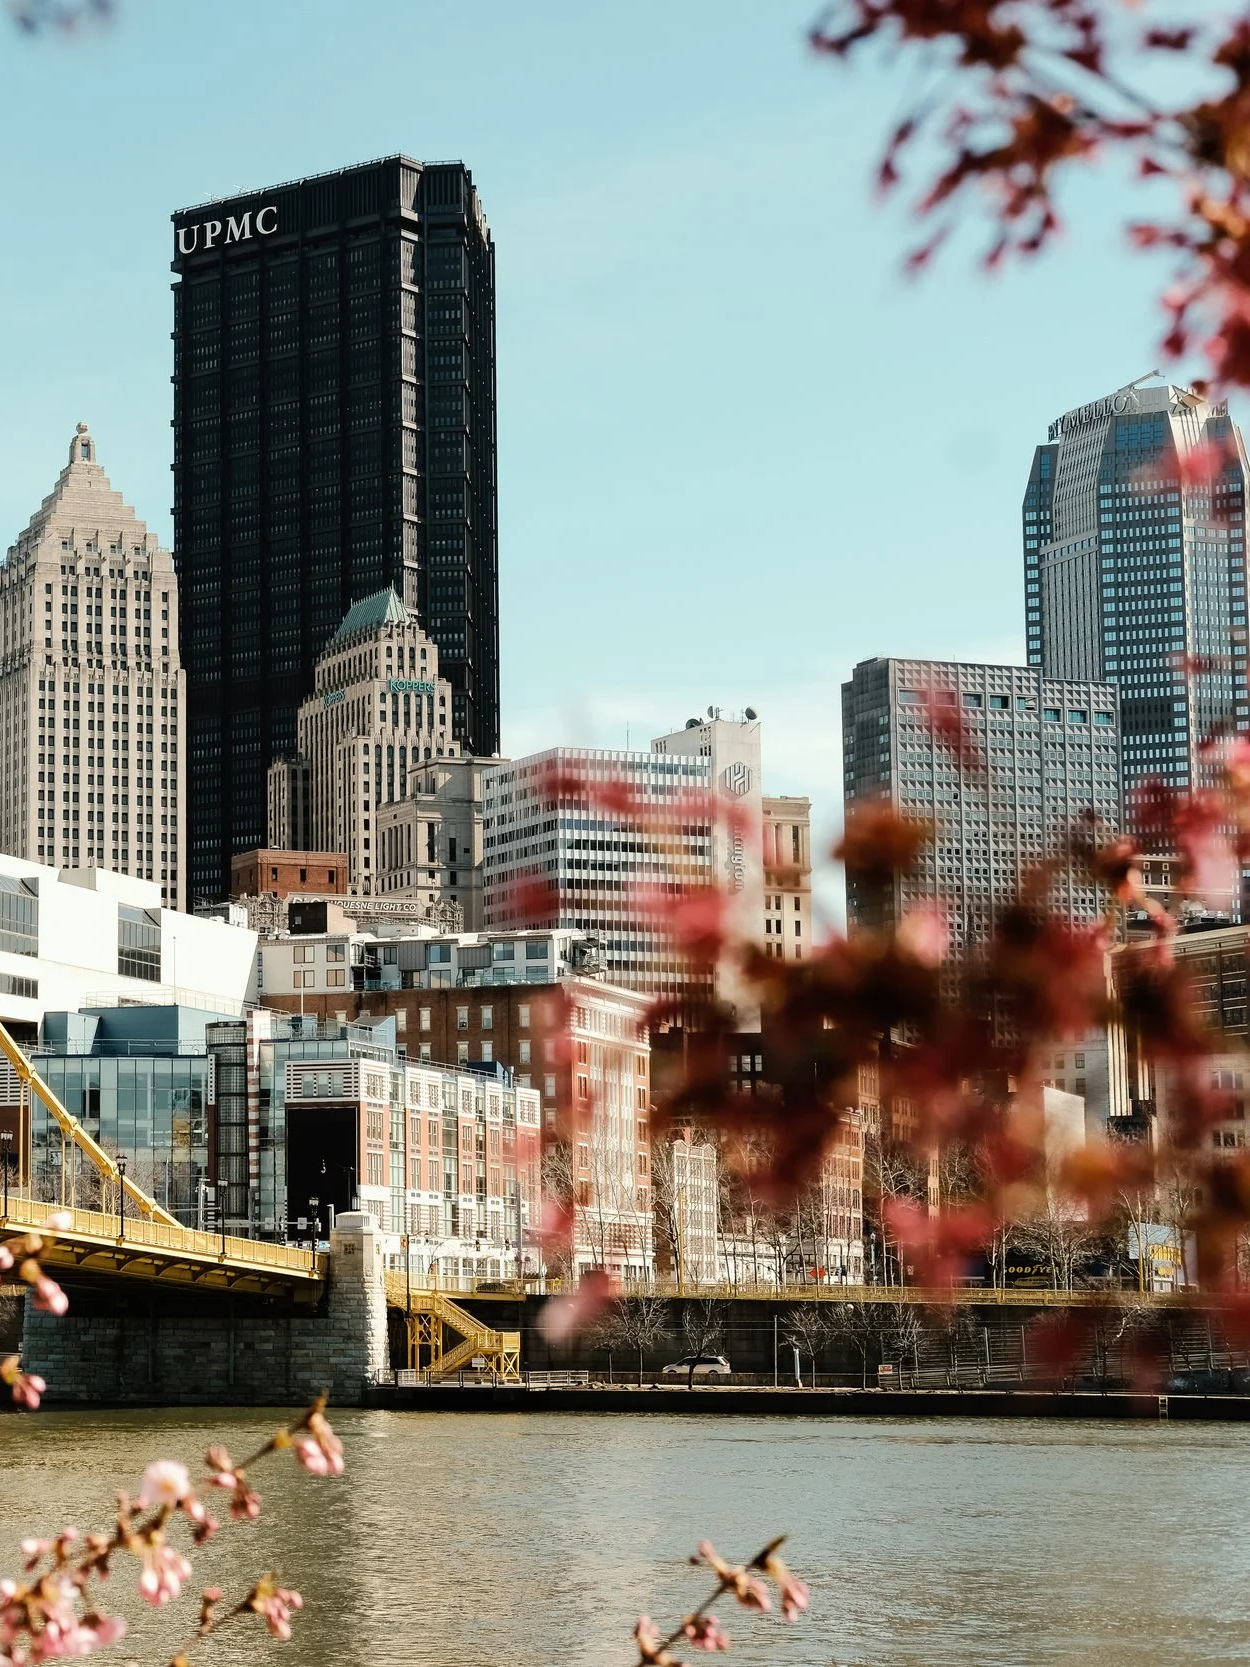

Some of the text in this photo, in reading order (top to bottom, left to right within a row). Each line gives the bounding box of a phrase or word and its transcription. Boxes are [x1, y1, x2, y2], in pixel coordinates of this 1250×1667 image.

[176, 206, 278, 254] UPMC
[390, 679, 437, 693] KOPPERS
[731, 803, 747, 890] ntington
[327, 900, 374, 910] QUESNE
[374, 902, 402, 911] LIGHT
[1002, 1264, 1061, 1274] OODYE
